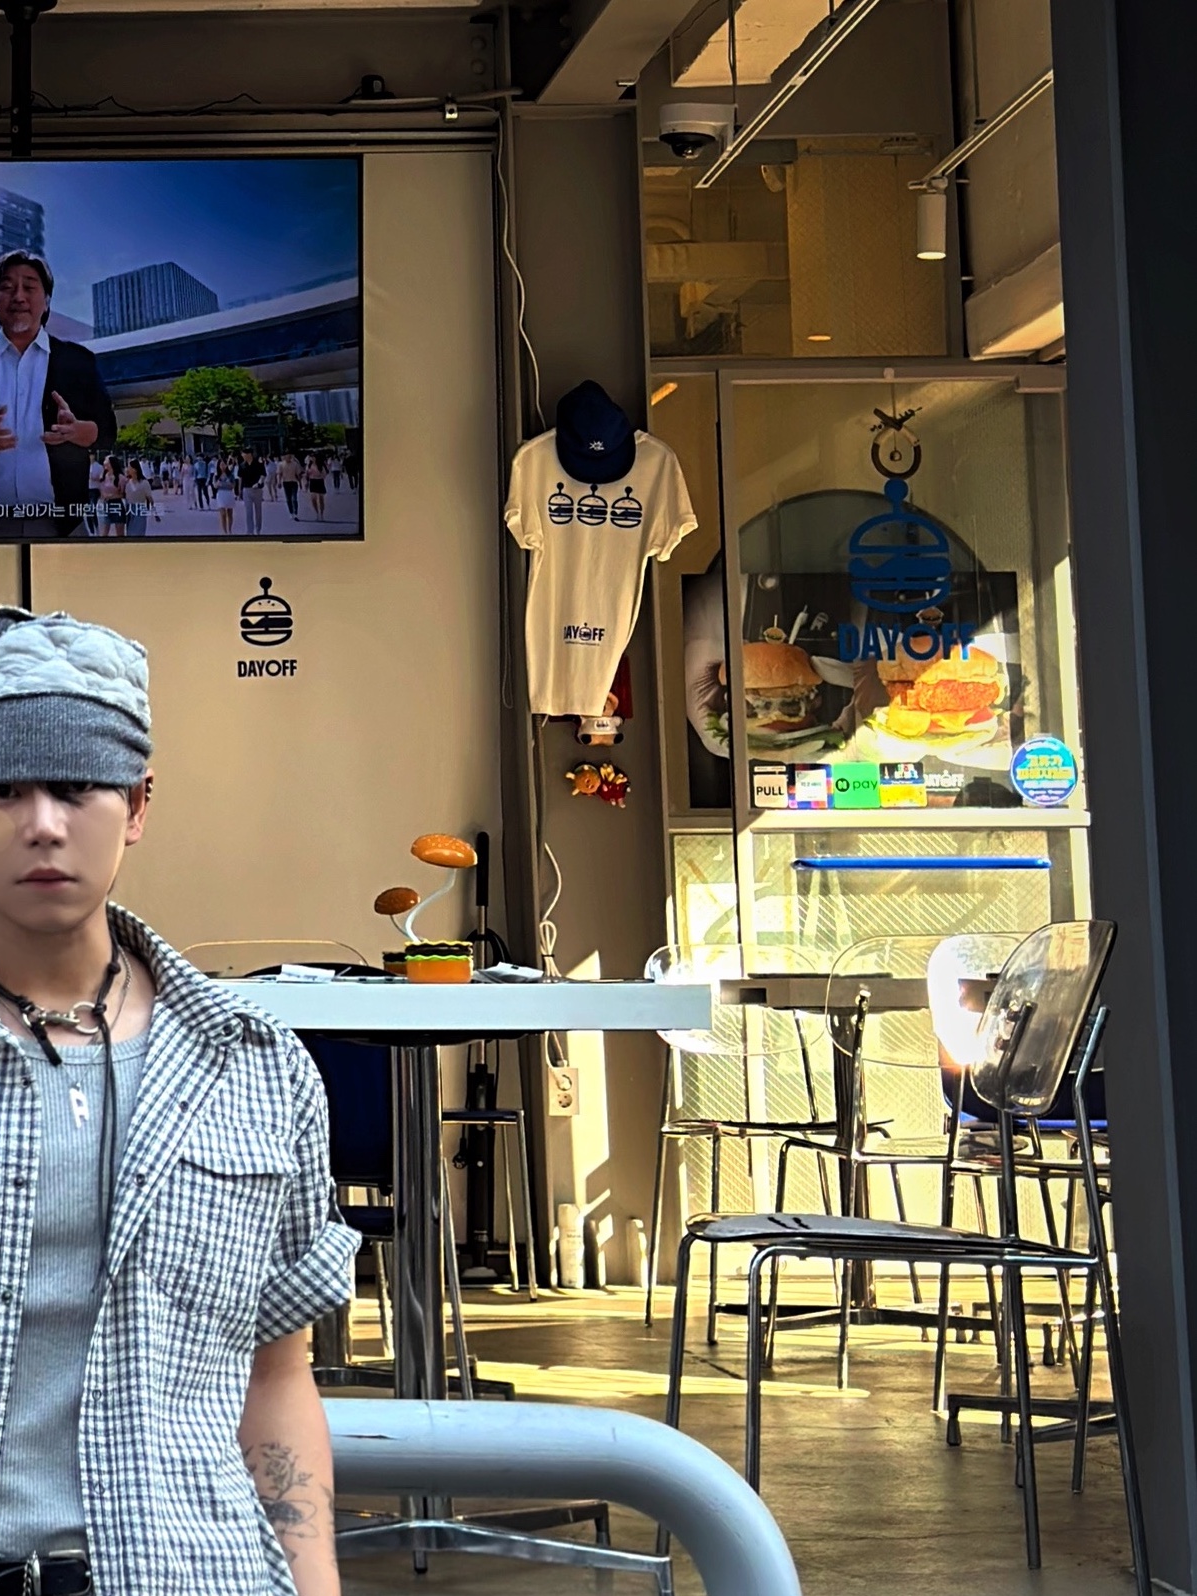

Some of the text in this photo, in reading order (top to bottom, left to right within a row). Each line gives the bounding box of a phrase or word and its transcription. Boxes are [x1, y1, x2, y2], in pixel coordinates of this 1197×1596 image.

[12, 503, 65, 517] 살아가는
[69, 503, 122, 517] 대한민국
[837, 622, 976, 662] DAYOFF
[237, 659, 297, 677] DAYOFF
[756, 786, 784, 796] PULL
[853, 780, 878, 791] pay
